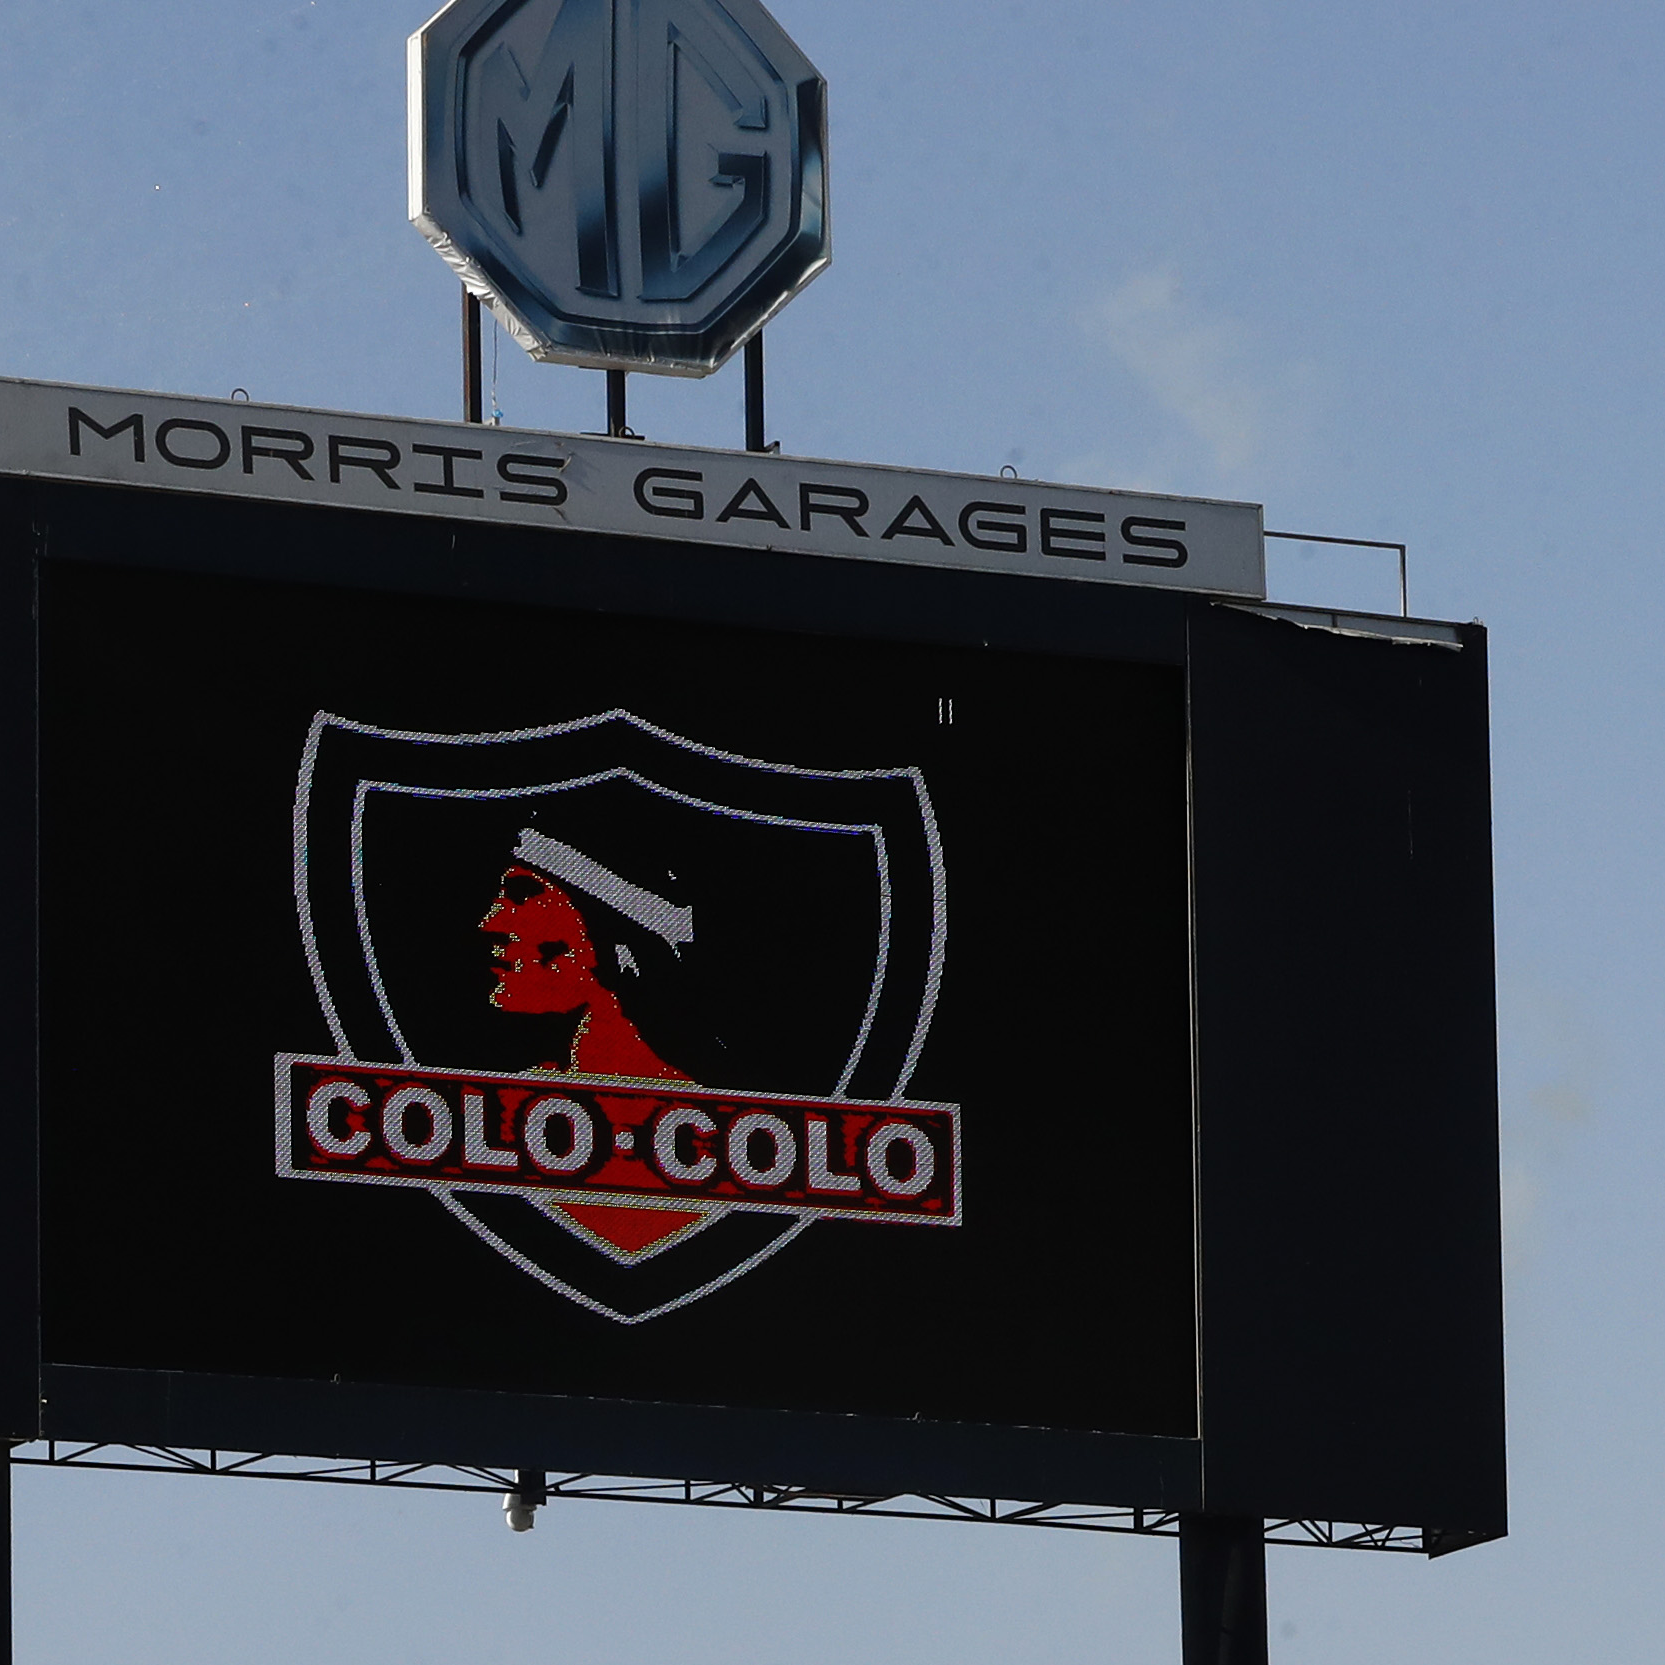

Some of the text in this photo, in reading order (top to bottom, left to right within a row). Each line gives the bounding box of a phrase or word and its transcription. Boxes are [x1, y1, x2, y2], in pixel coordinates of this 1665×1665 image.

[475, 0, 775, 308] MG
[67, 405, 1189, 569] MORRIS GARAGES
